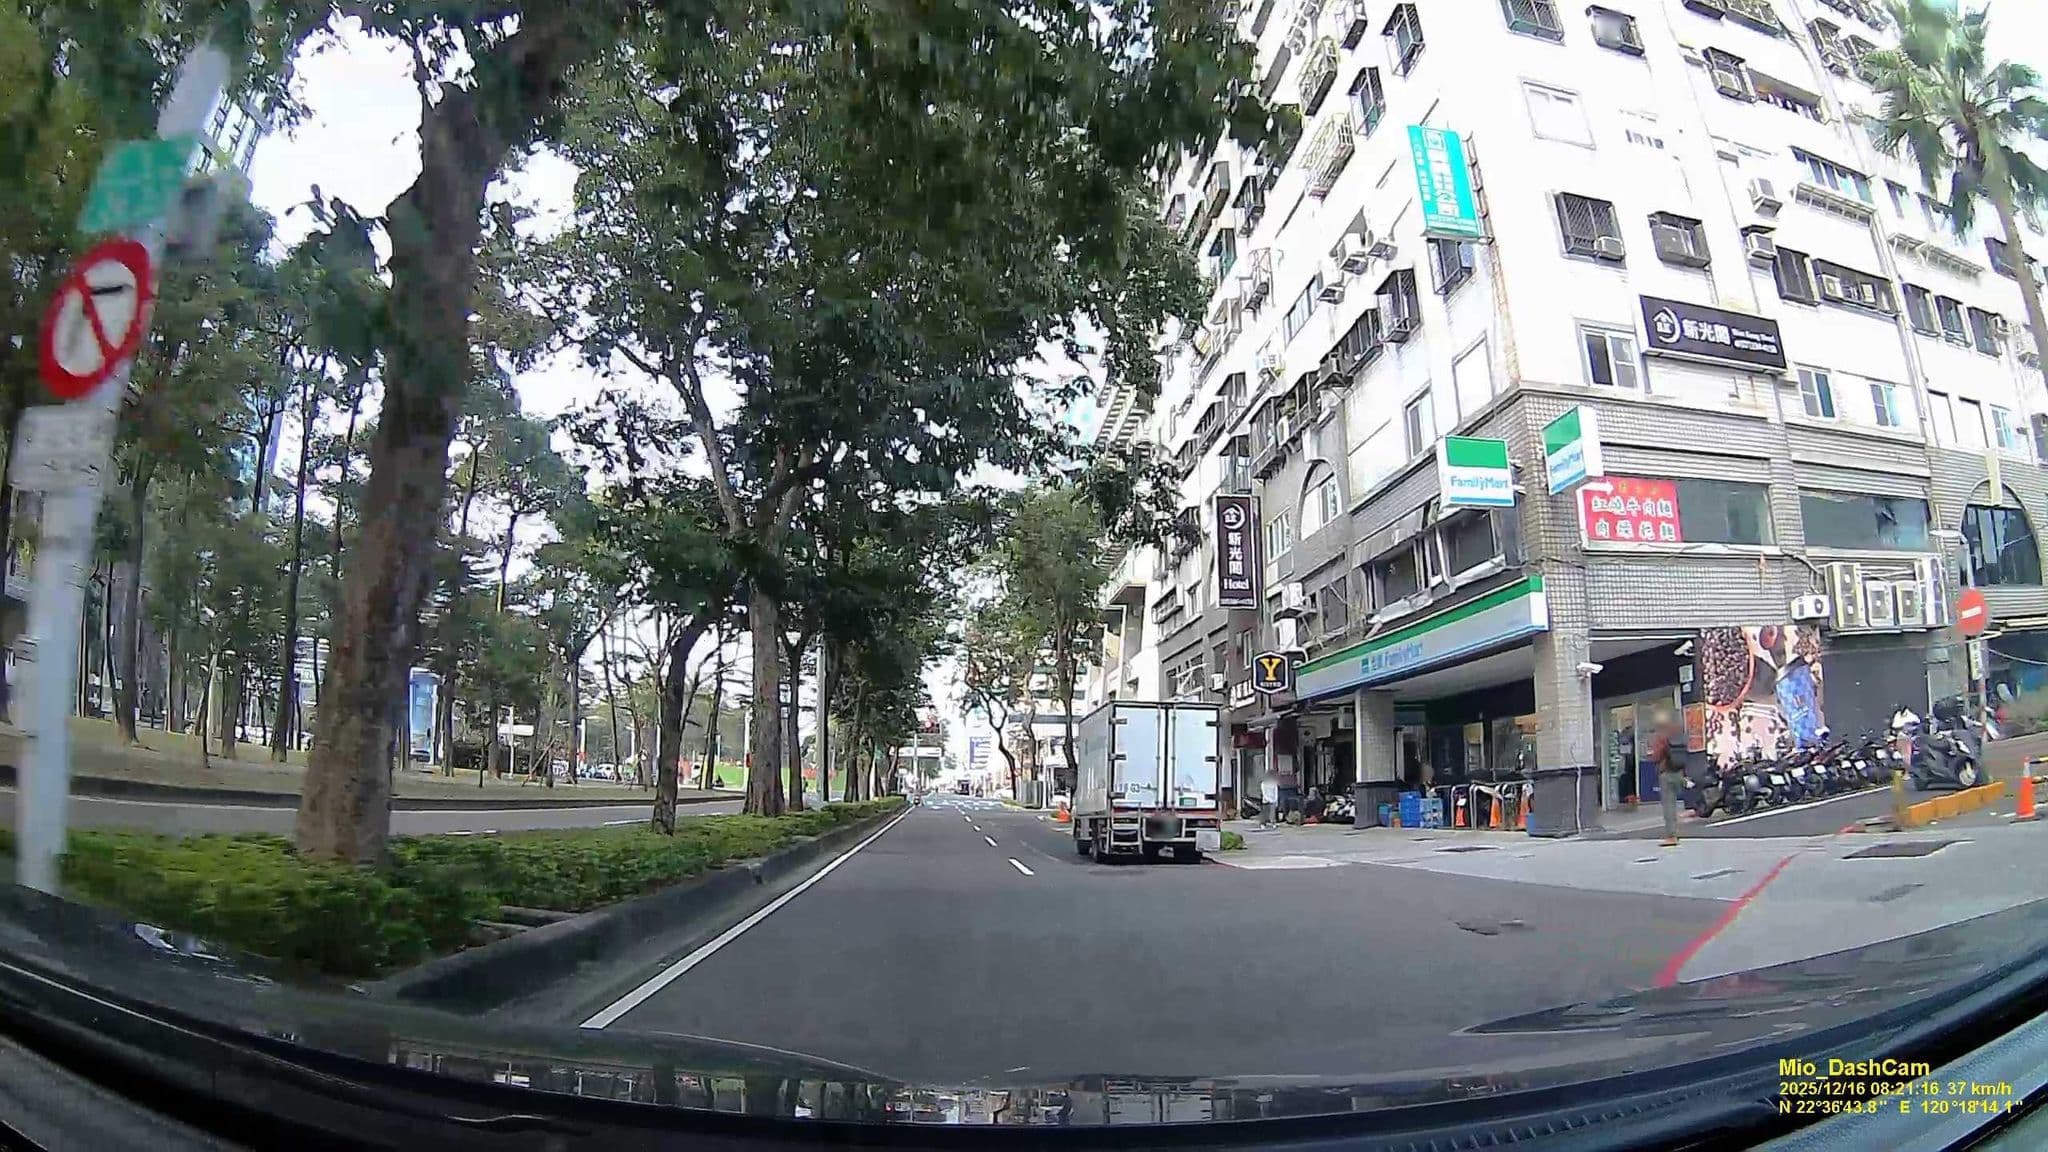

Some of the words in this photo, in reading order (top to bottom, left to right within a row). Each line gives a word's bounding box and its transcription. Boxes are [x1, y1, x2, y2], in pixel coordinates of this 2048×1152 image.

[1450, 475, 1508, 490] FamilyMart
[1223, 578, 1249, 590] Hotel
[1259, 658, 1281, 681] Y
